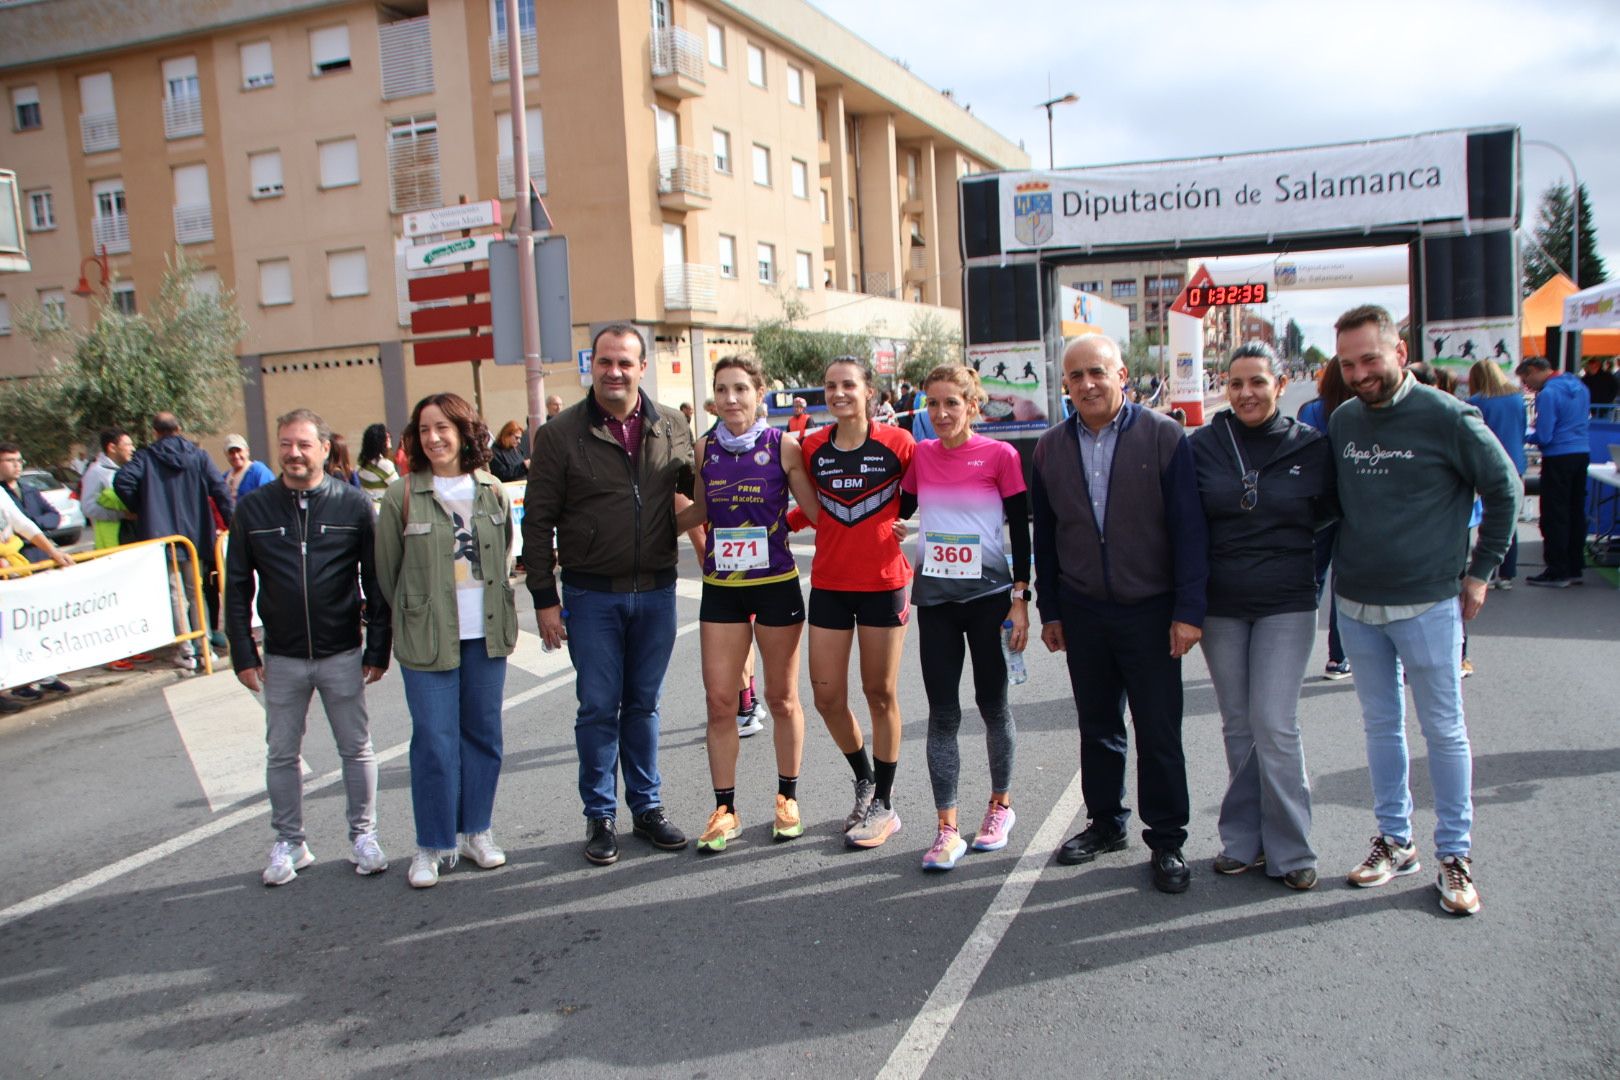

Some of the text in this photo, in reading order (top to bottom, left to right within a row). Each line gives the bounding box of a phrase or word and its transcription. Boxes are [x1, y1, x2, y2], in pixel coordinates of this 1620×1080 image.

[1062, 165, 1441, 221] Diputación de Salamanca
[1343, 441, 1414, 465] Pepe Jeans
[844, 478, 863, 488] BM
[722, 541, 757, 558] 271
[933, 545, 973, 563] 360
[12, 590, 119, 631] Diputación
[16, 617, 150, 664] de Salamanca
